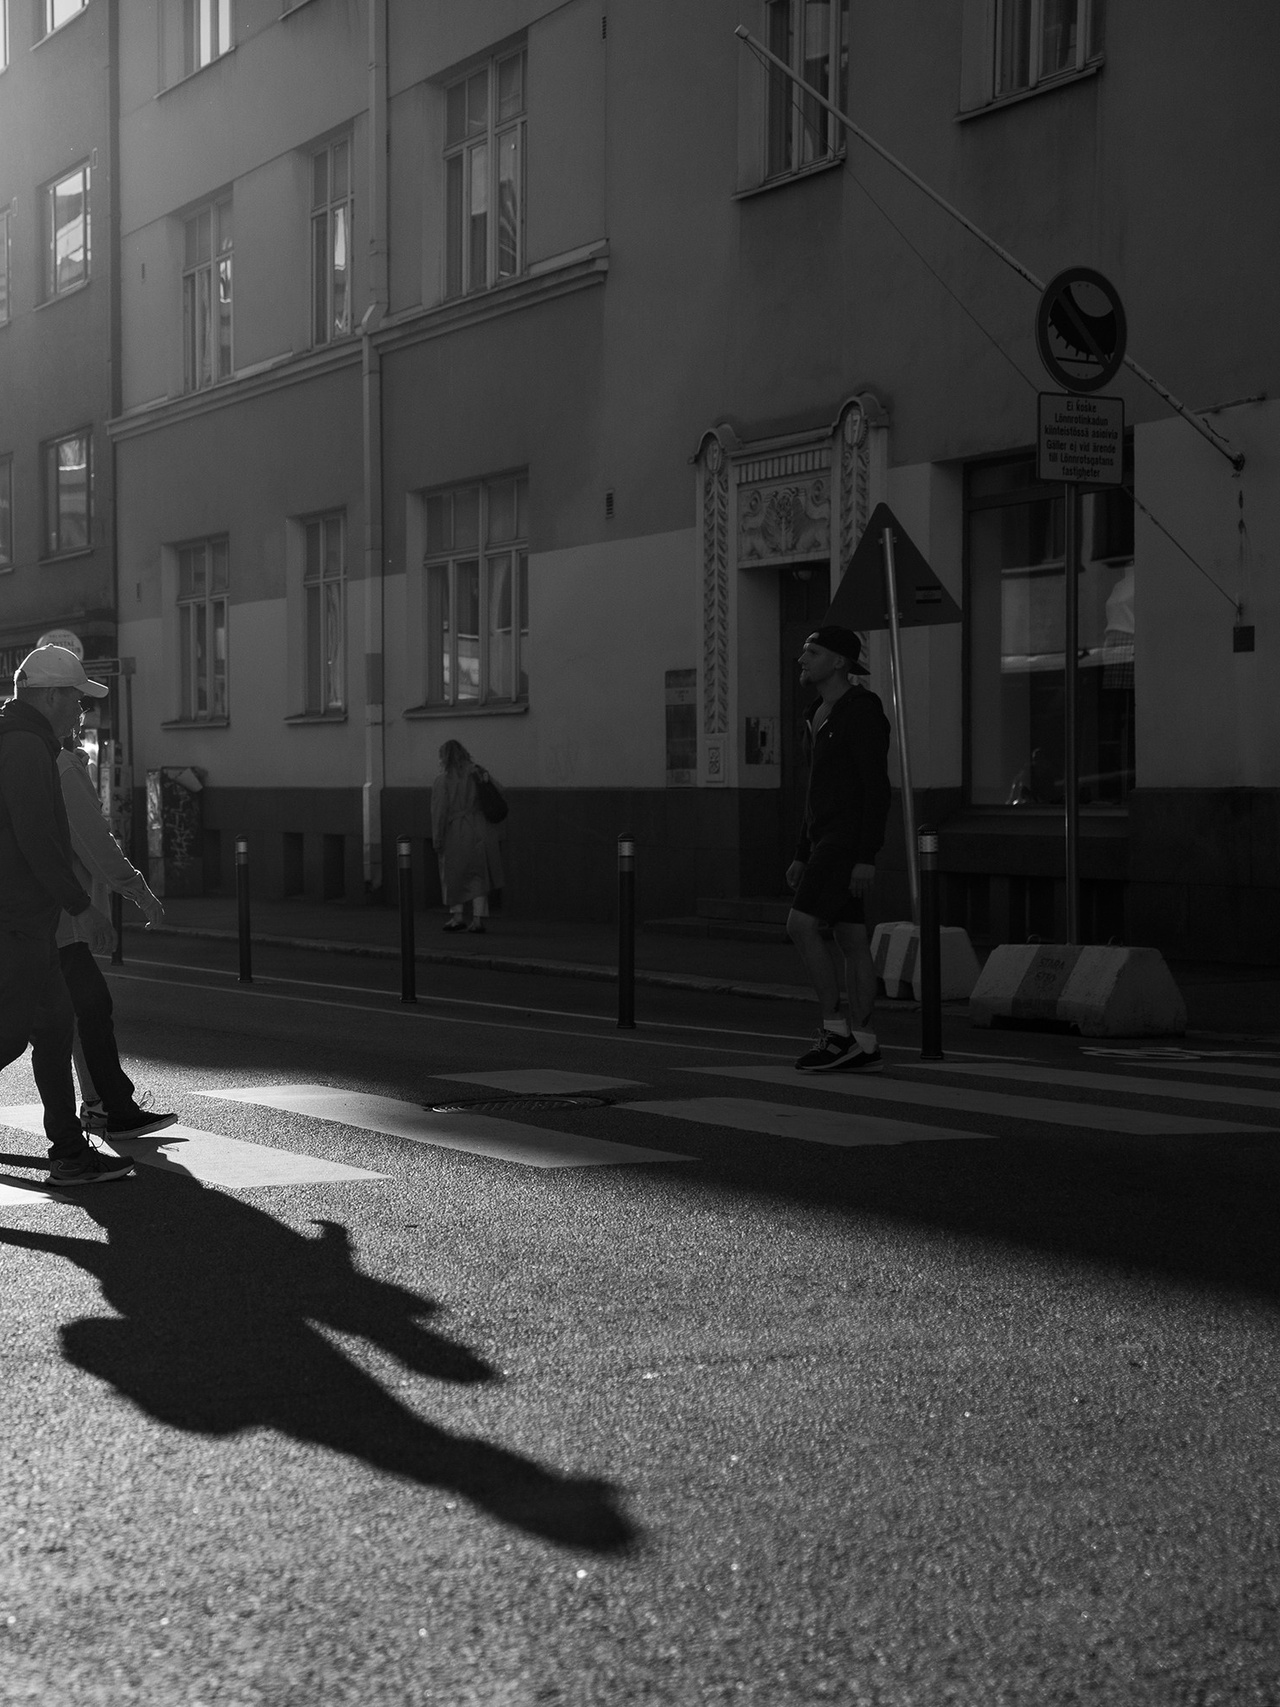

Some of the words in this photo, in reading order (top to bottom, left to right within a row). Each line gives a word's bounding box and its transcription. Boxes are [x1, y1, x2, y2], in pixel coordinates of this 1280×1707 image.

[1066, 400, 1074, 411] Ei
[1076, 400, 1097, 413] koske
[1046, 439, 1067, 450] Gäller
[1070, 441, 1077, 452] ej
[1080, 442, 1090, 452] vid
